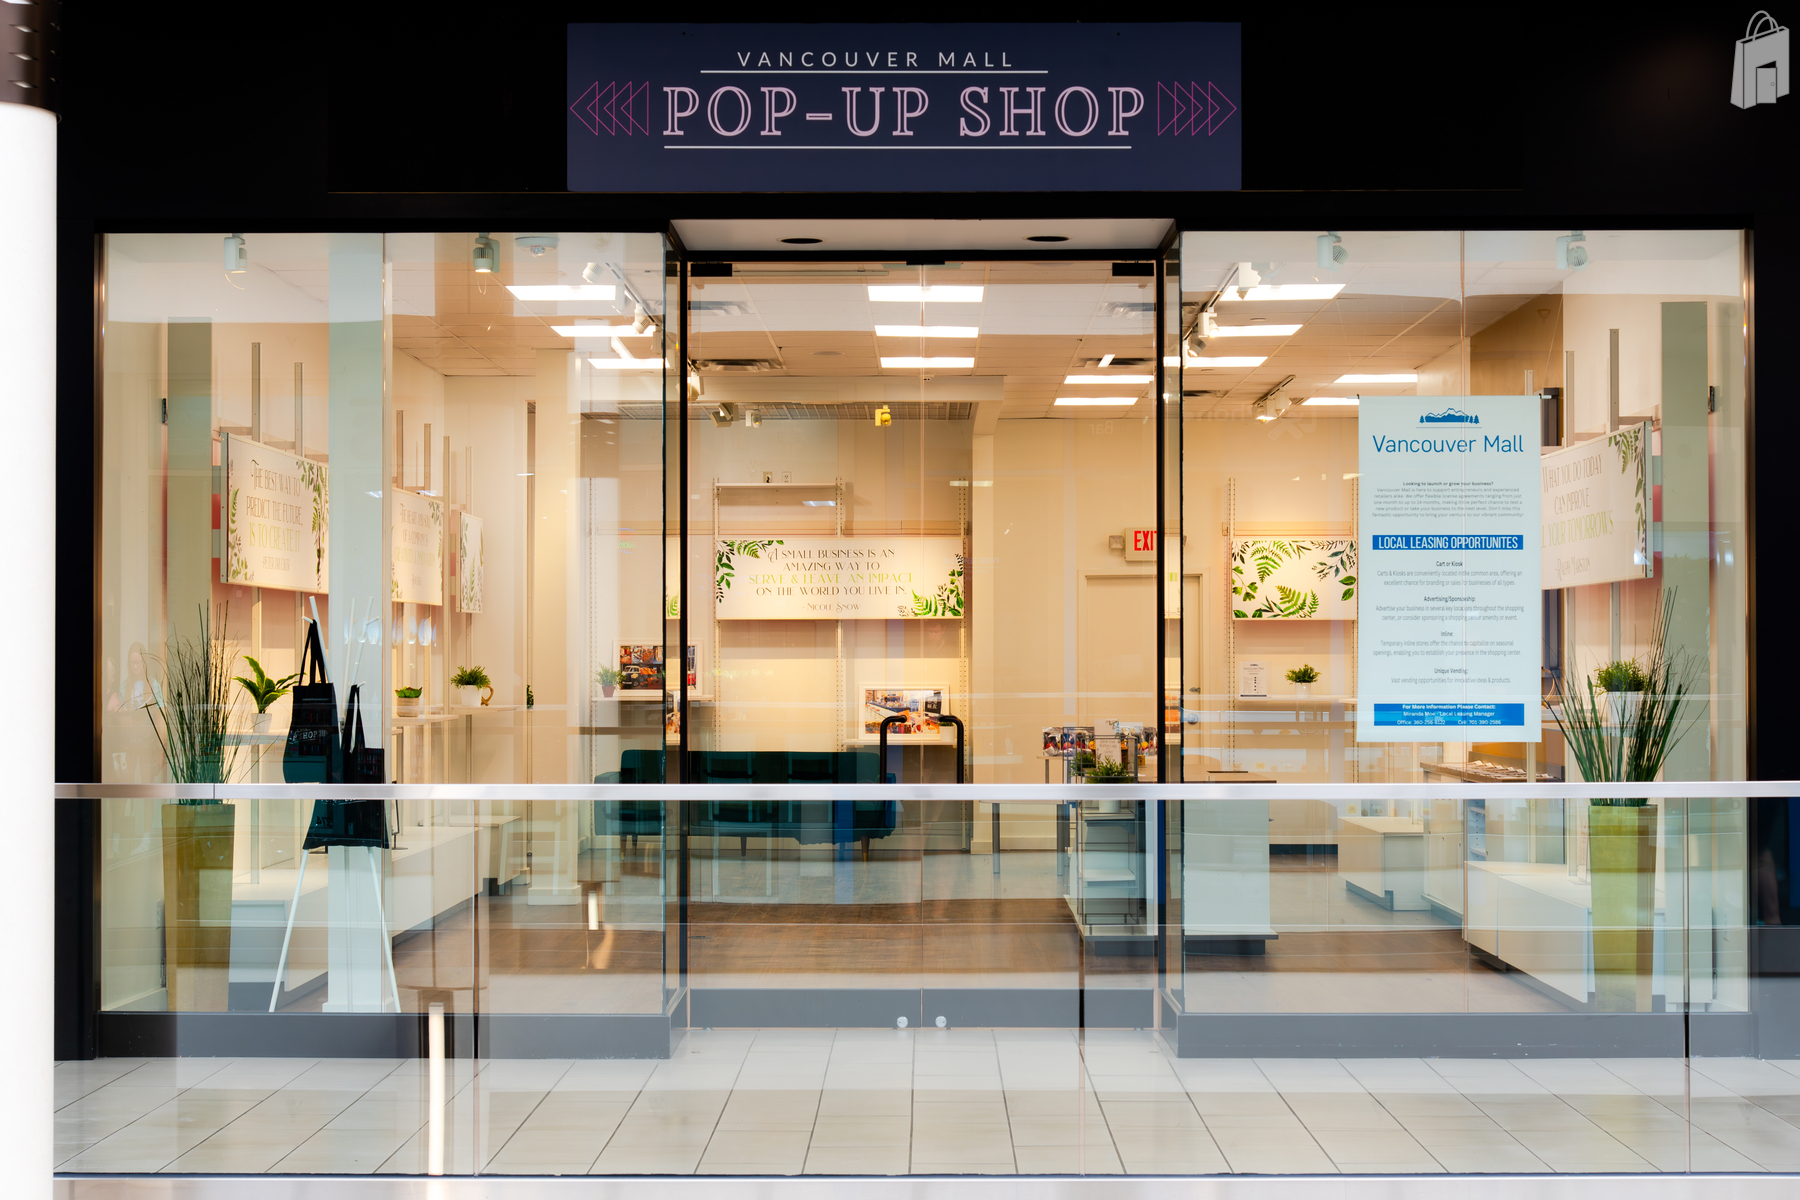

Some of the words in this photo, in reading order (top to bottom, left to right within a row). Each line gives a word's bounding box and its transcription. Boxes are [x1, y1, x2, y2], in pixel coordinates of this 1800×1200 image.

[738, 52, 918, 68] VANCOUVER
[938, 52, 1013, 68] MALL
[663, 86, 930, 136] POP-UP
[960, 86, 1145, 136] SHOP
[1372, 435, 1476, 452] Vancouver
[1484, 435, 1524, 452] Mall
[1542, 466, 1560, 494] WHAT
[1573, 460, 1581, 482] DO
[1582, 454, 1602, 480] TODAY
[265, 470, 277, 492] BEST
[279, 473, 291, 494] WAY
[293, 477, 301, 497] TO
[246, 496, 270, 520] PREDICT
[272, 501, 281, 522] THE
[1549, 521, 1566, 547] YOUR
[1567, 510, 1614, 543] TOMORROWS
[258, 524, 267, 548] TO
[269, 526, 293, 552] CREATE
[1134, 530, 1157, 552] EXI
[1378, 537, 1408, 549] LOCAL
[1410, 537, 1449, 549] LEASING
[1451, 537, 1518, 549] OPPORTUNITES
[768, 548, 778, 563] A
[781, 549, 812, 559] SMALL
[818, 549, 864, 559] BUSINESS
[868, 549, 876, 559] IS
[882, 549, 894, 558] AN
[784, 561, 831, 572] AMAZING
[835, 561, 861, 571] WAY
[865, 561, 880, 571] TO
[749, 573, 786, 584] SERVE
[791, 573, 798, 584] &
[803, 573, 841, 584] LEAVE
[848, 573, 864, 583] AN
[868, 572, 913, 583] IMPACT
[756, 586, 772, 596] ON
[776, 586, 795, 596] THE
[800, 586, 839, 596] WORLD
[843, 586, 865, 596] YOU
[868, 586, 891, 595] LIVE
[895, 586, 907, 595] IN.
[807, 602, 833, 611] NICOLE
[836, 602, 861, 612] SNOW
